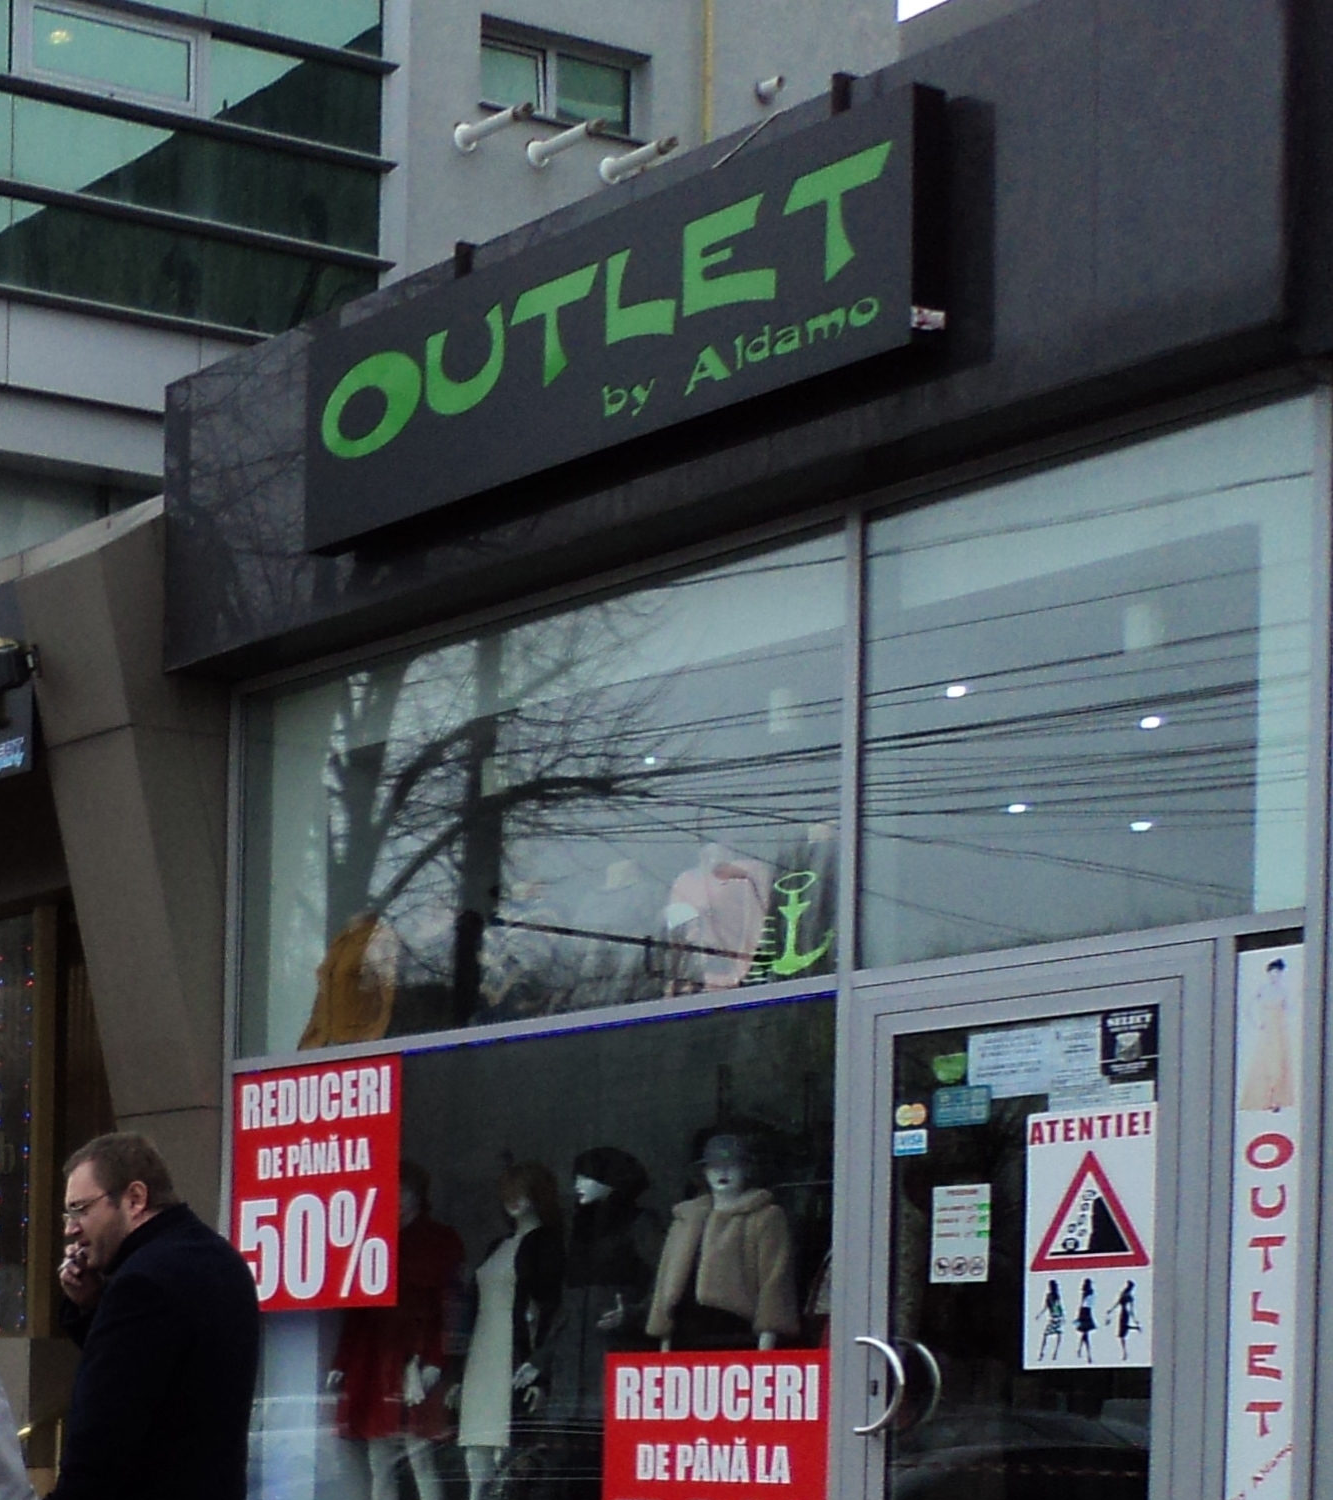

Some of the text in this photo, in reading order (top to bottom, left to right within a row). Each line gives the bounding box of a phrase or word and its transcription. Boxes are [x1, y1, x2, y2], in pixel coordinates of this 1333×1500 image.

[320, 140, 892, 459] OUTLET
[602, 297, 880, 417] by Aldamo
[241, 1065, 391, 1130] REDUCERI
[1029, 1111, 1152, 1145] ATENTIE!
[258, 1134, 371, 1180] DE PÂNĂ LA
[240, 1187, 388, 1302] 50%
[1245, 1133, 1294, 1437] OUTLET
[615, 1364, 820, 1421] REDUCERI
[637, 1437, 790, 1484] DE PÂNĂ LA
